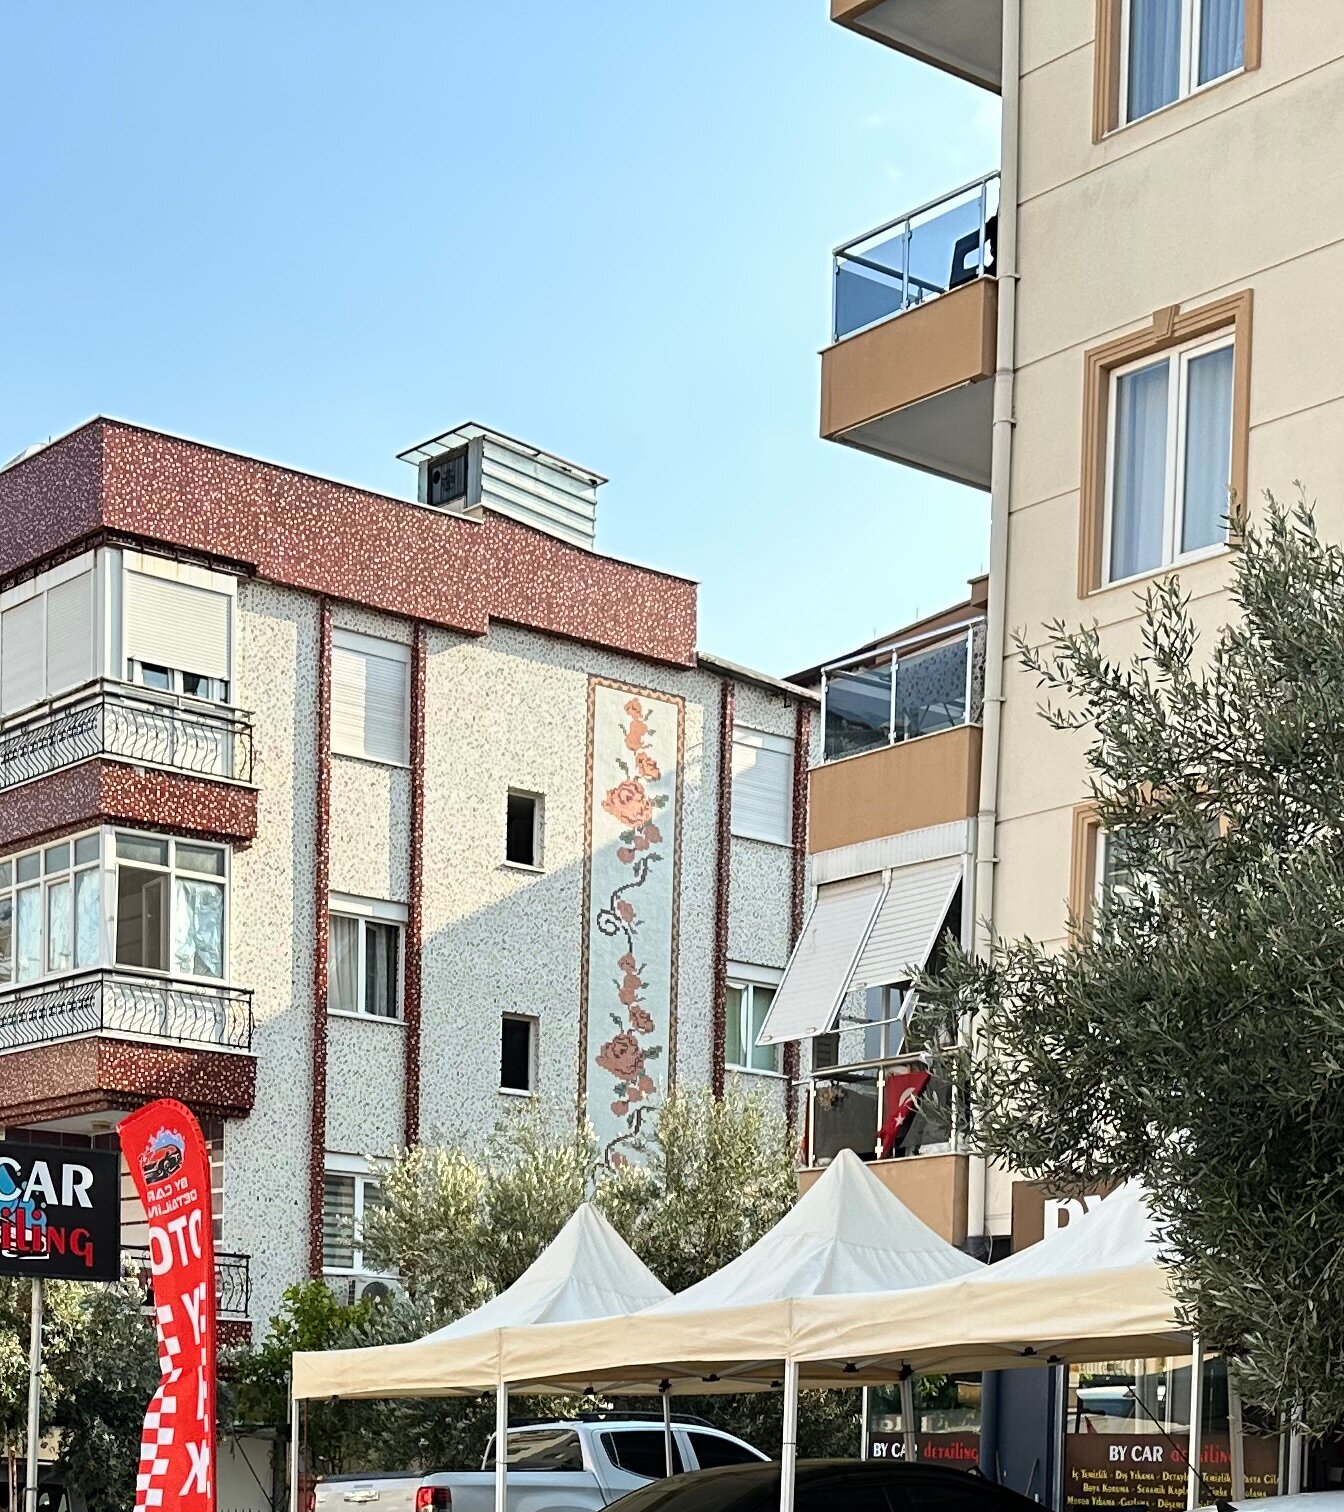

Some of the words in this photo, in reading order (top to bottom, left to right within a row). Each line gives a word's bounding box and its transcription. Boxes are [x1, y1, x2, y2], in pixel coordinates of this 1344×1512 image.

[873, 1442, 889, 1458] BY
[891, 1442, 917, 1458] CA
[1109, 1445, 1128, 1462] BY
[1131, 1445, 1164, 1462] CAR
